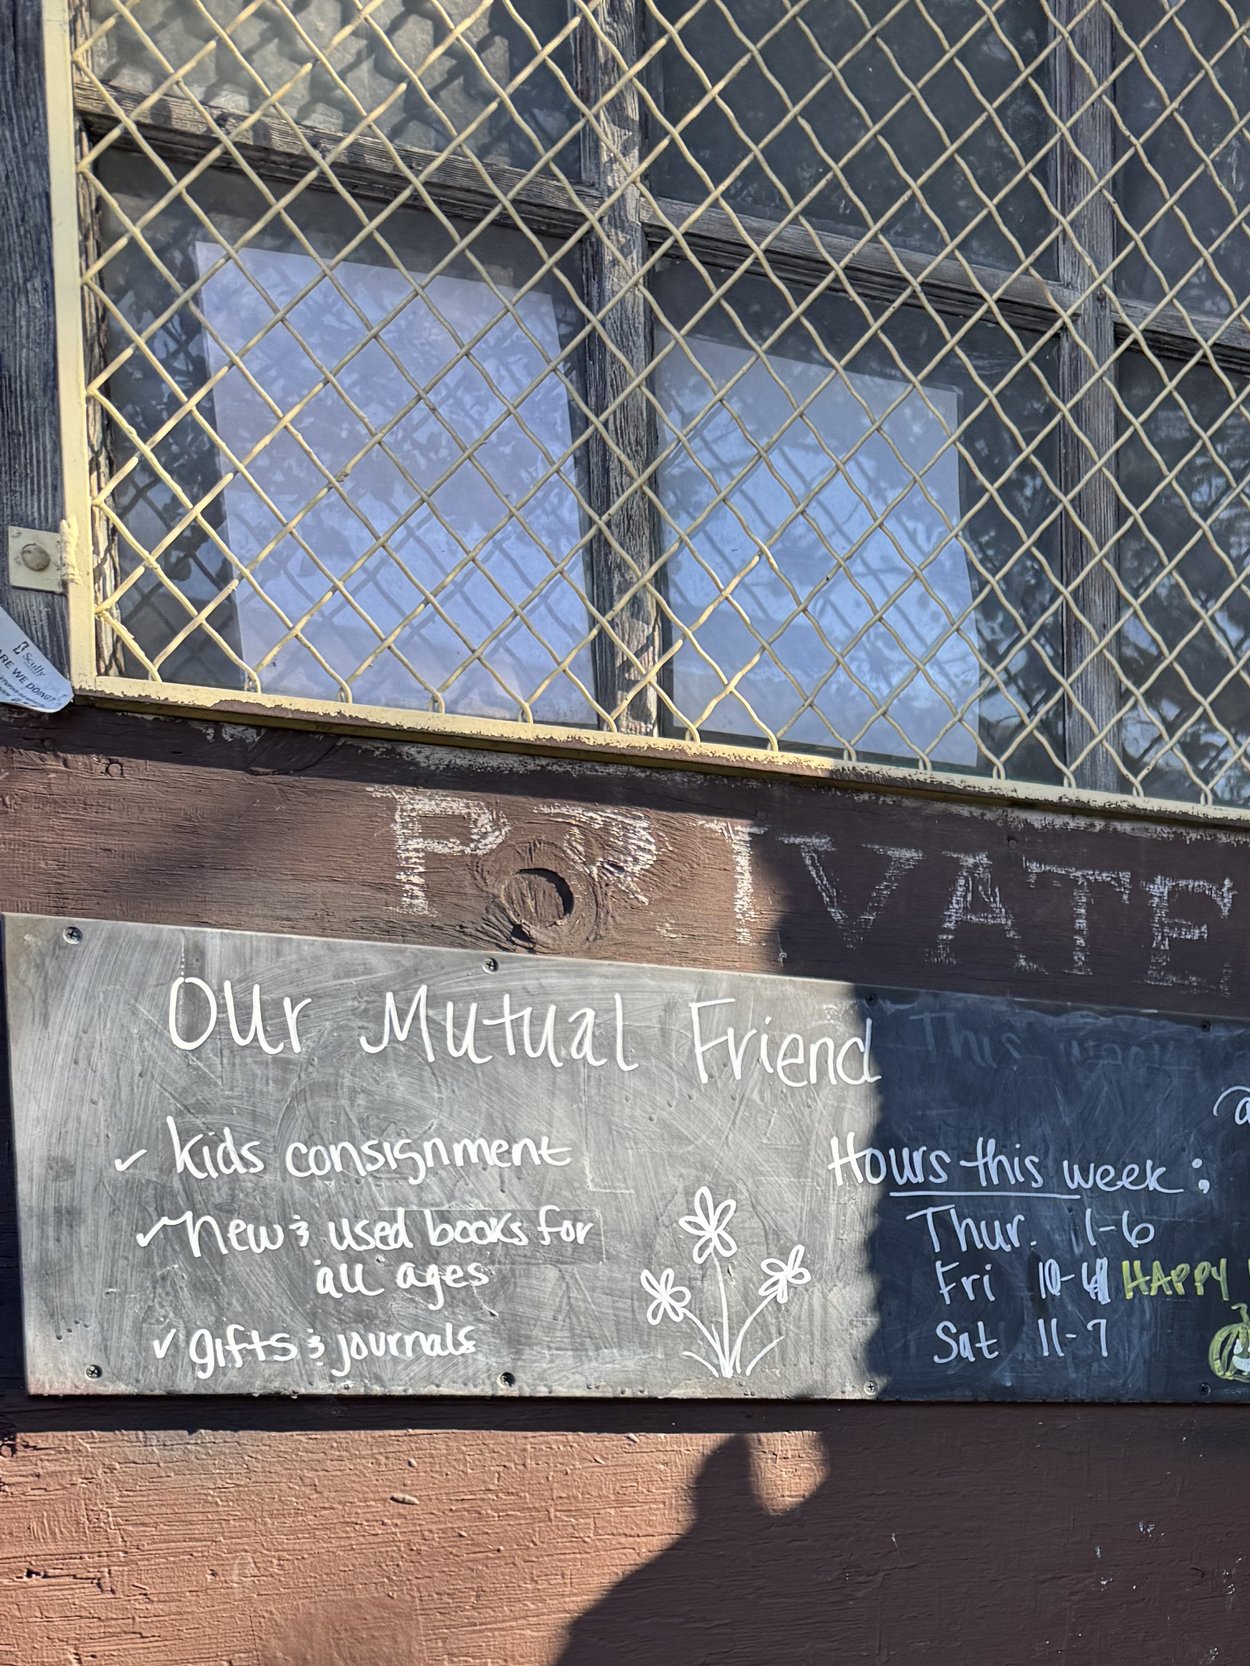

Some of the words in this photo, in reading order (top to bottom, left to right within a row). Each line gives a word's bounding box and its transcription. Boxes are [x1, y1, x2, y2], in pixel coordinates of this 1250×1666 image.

[12, 668, 29, 684] WE
[688, 998, 883, 1087] Friend
[166, 1115, 266, 1179] kids
[285, 1132, 573, 1185] consignment
[827, 1131, 952, 1187] Hours
[959, 1136, 1044, 1188] this
[328, 1206, 414, 1252] used
[425, 1208, 530, 1247] books
[538, 1205, 595, 1247] for
[905, 1203, 1037, 1253] Thur.
[1085, 1206, 1155, 1249] 1-6
[313, 1259, 385, 1299] all
[395, 1261, 491, 1311] ages
[935, 1259, 995, 1305] Fri
[1121, 1256, 1231, 1302] HAPPY
[188, 1323, 299, 1380] gifts
[330, 1321, 478, 1378] journals
[932, 1319, 1000, 1365] Sat
[1036, 1317, 1109, 1358] 11-7
